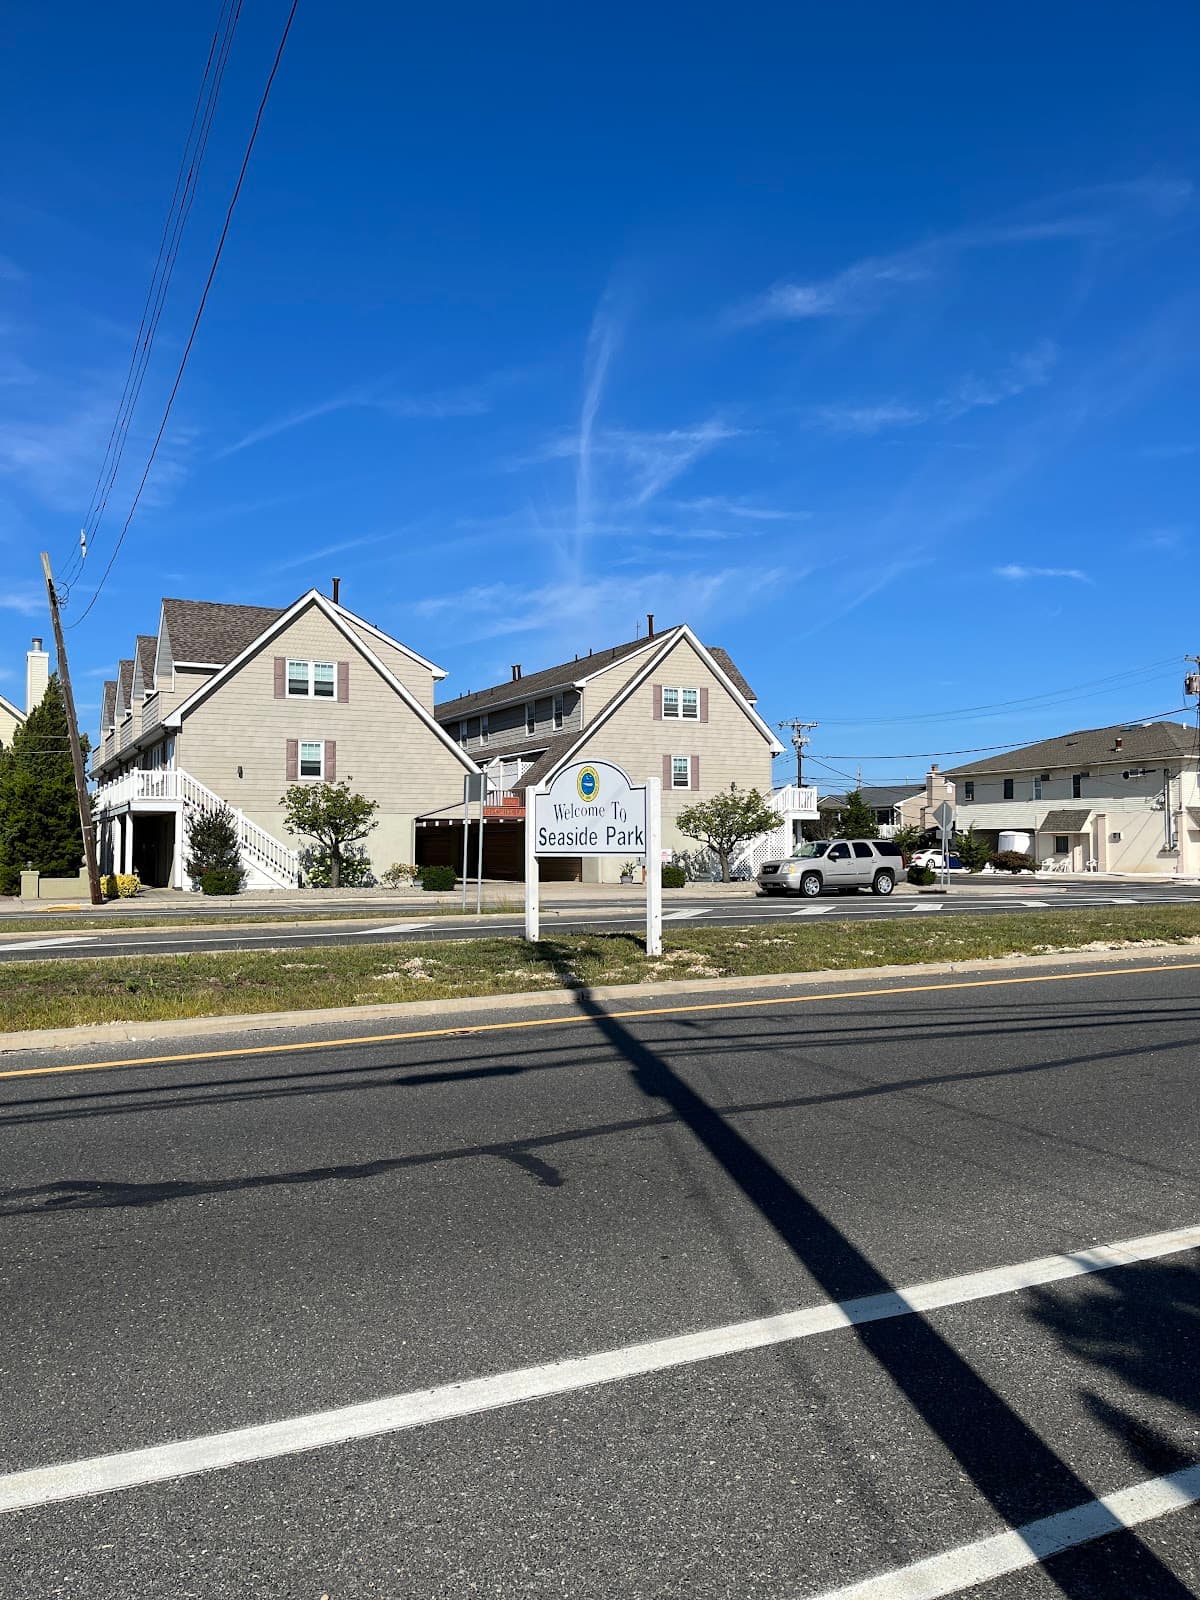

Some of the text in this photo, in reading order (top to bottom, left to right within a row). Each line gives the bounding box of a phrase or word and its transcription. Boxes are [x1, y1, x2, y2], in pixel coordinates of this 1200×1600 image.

[553, 801, 627, 823] Welcome To
[538, 825, 644, 846] Seaside Park
